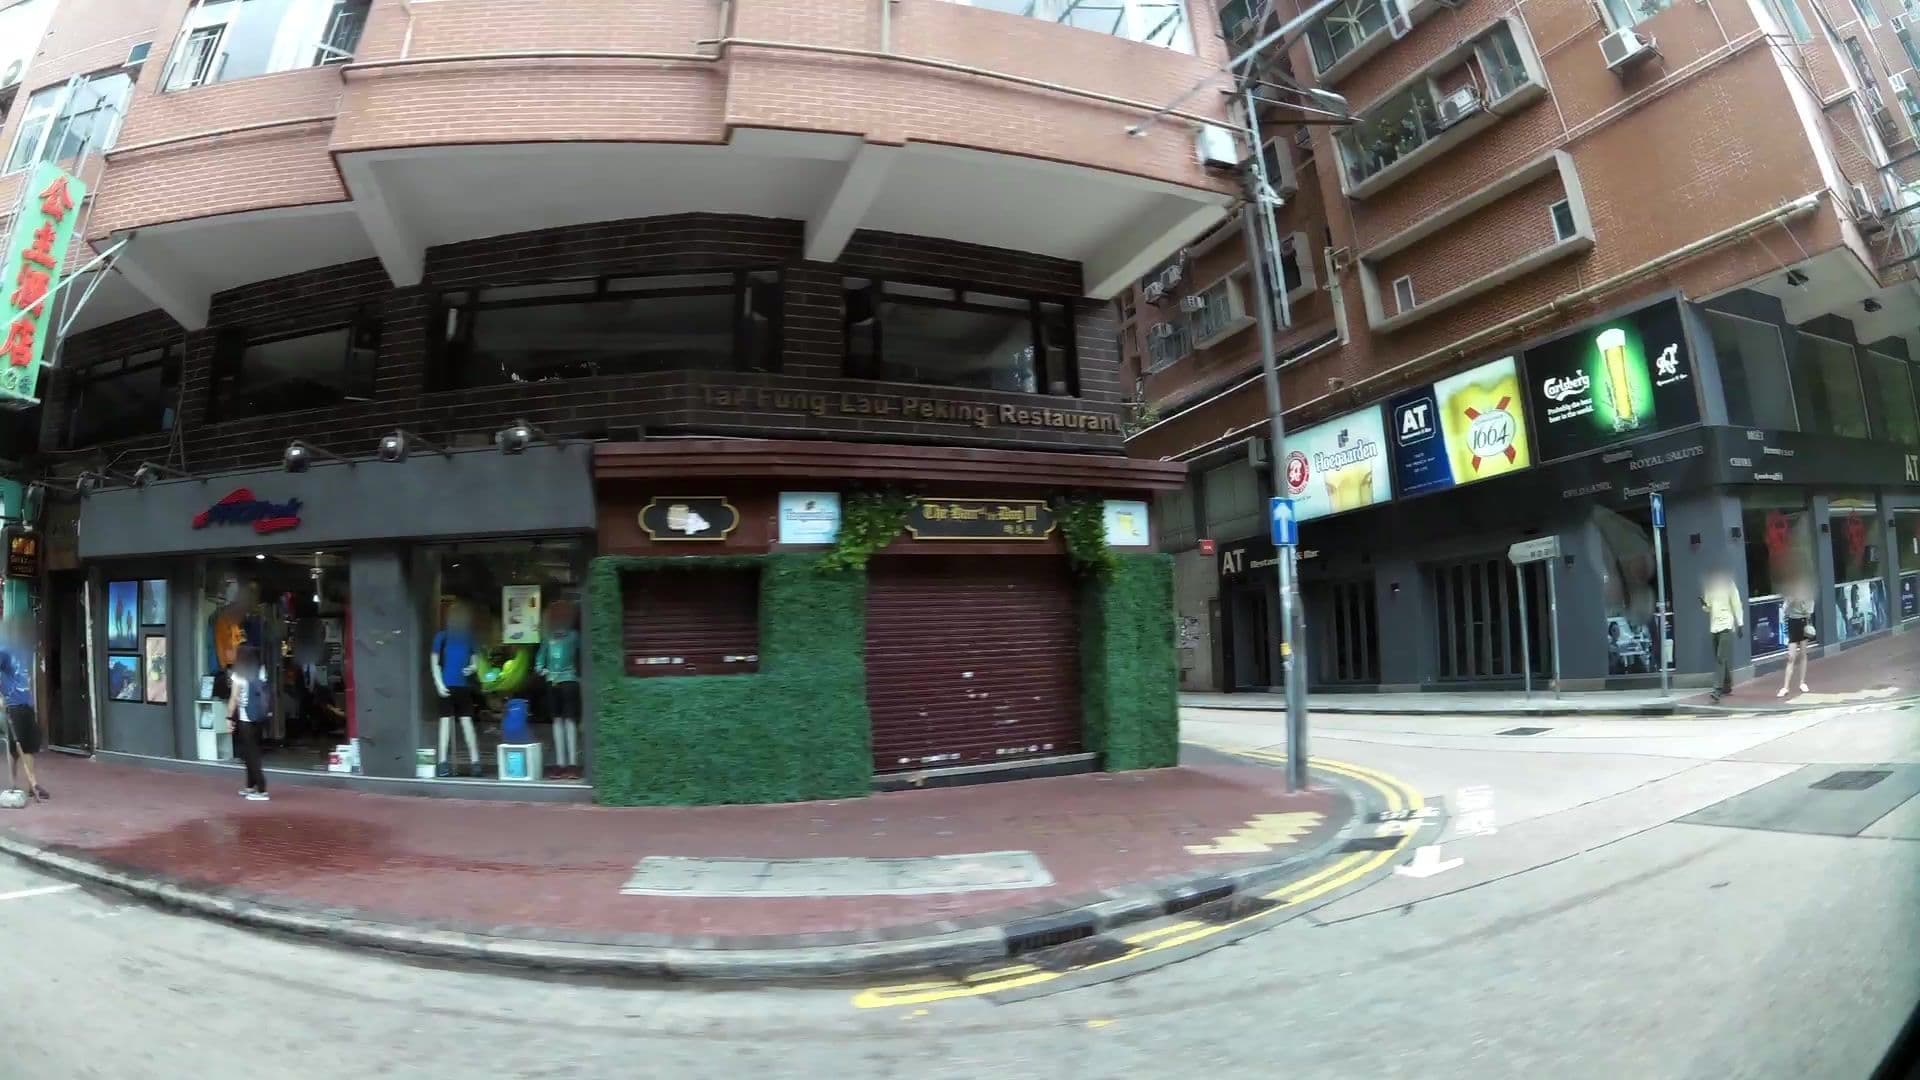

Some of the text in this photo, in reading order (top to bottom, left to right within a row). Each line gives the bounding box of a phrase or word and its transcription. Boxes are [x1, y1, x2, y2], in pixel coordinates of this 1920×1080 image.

[1543, 369, 1590, 401] Carlsberg
[757, 387, 826, 416] Fung
[839, 393, 889, 415] Lau
[901, 397, 988, 428] Peking
[999, 403, 1121, 432] Restaurant
[1402, 404, 1429, 434] AT
[1473, 420, 1510, 450] 1664
[1312, 438, 1379, 474] Hoegaarden
[1629, 455, 1665, 471] ROYAL
[1665, 445, 1705, 463] SALUTE
[1904, 453, 1920, 482] AT
[1222, 548, 1246, 577] AT
